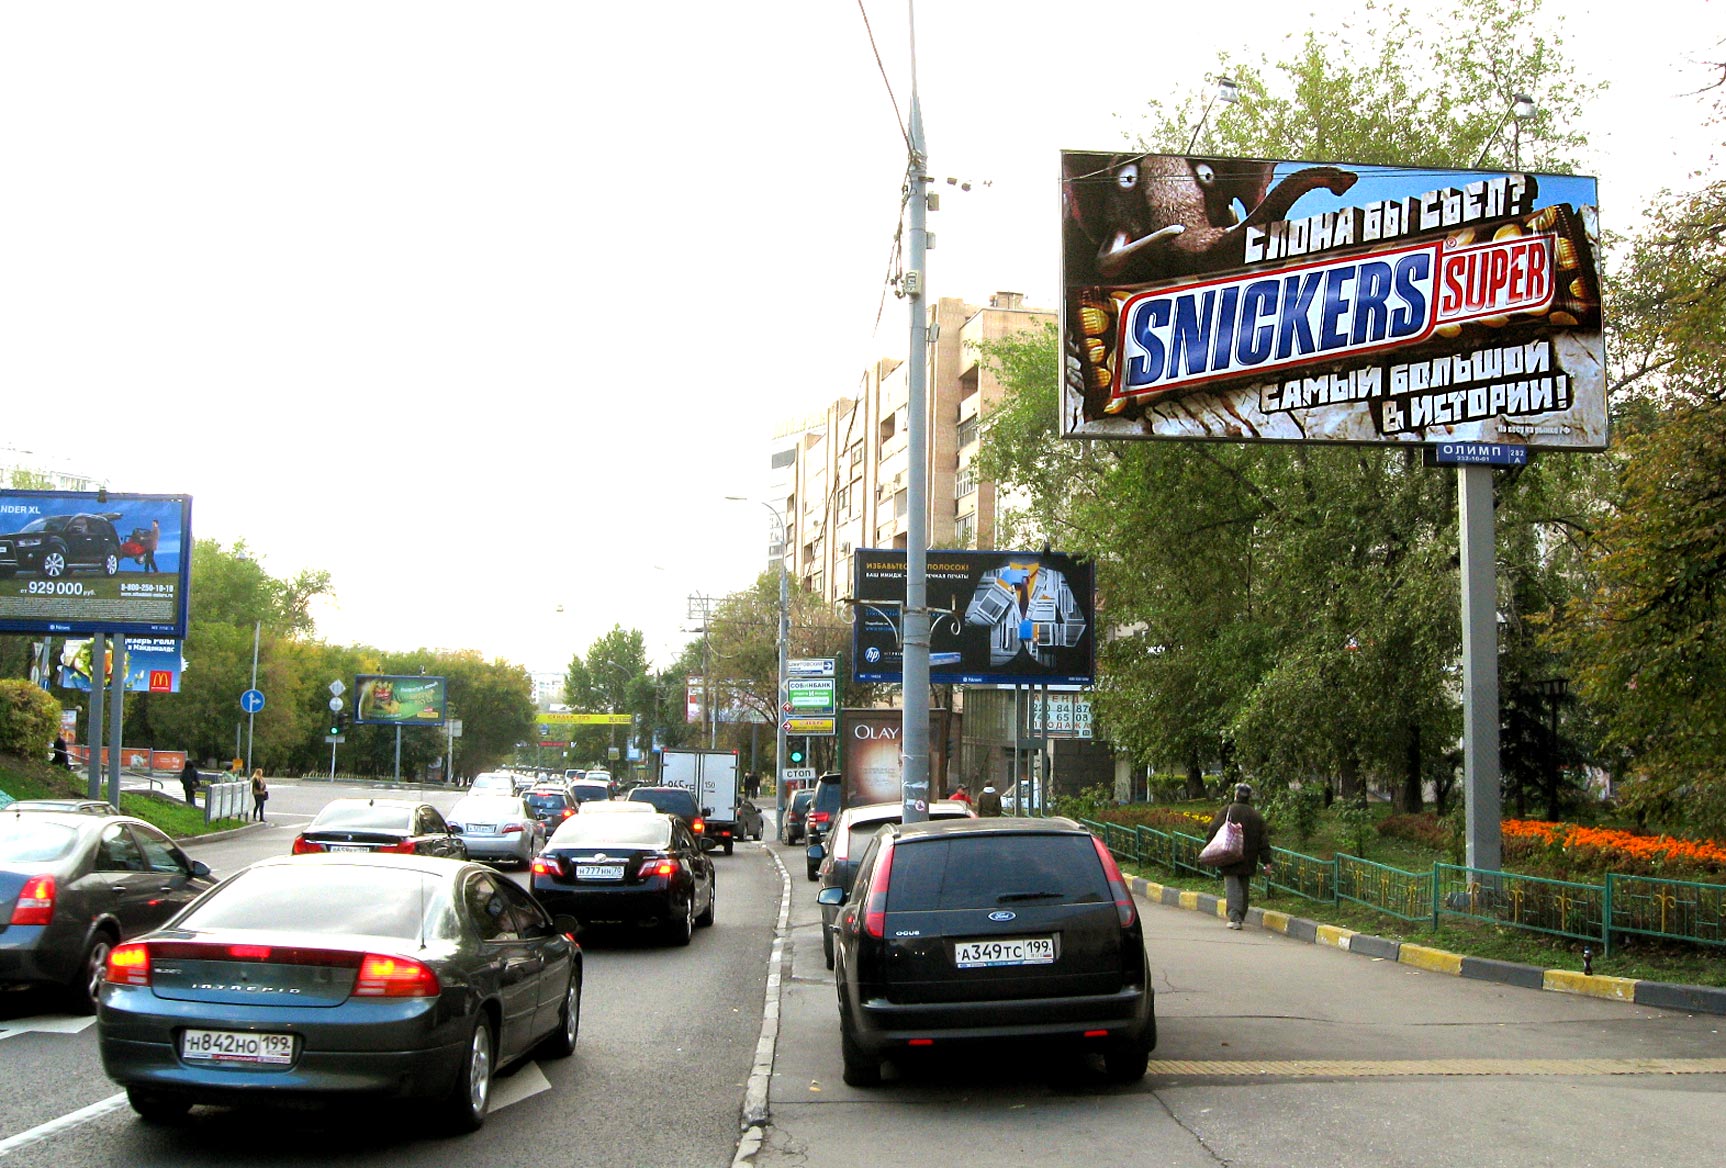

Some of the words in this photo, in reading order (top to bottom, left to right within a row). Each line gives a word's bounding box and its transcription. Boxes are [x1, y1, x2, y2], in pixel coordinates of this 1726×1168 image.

[1245, 206, 1355, 263] СЛОНА
[1363, 196, 1411, 241] БЫ
[1127, 254, 1430, 387] SNICKERS
[1441, 242, 1546, 317] SUPER
[1261, 366, 1382, 412] САМЫЙ
[1390, 340, 1550, 395] БОЛЬШОЙ
[1443, 445, 1501, 456] ОЛИМП
[1510, 449, 1524, 457] 282
[28, 506, 41, 515] XL
[29, 581, 55, 594] 929
[56, 582, 83, 595] 000
[1057, 704, 1070, 712] 84
[1076, 704, 1089, 713] 87
[1057, 713, 1069, 721] 65
[1026, 940, 1049, 953] 199
[262, 1035, 290, 1050] 199
